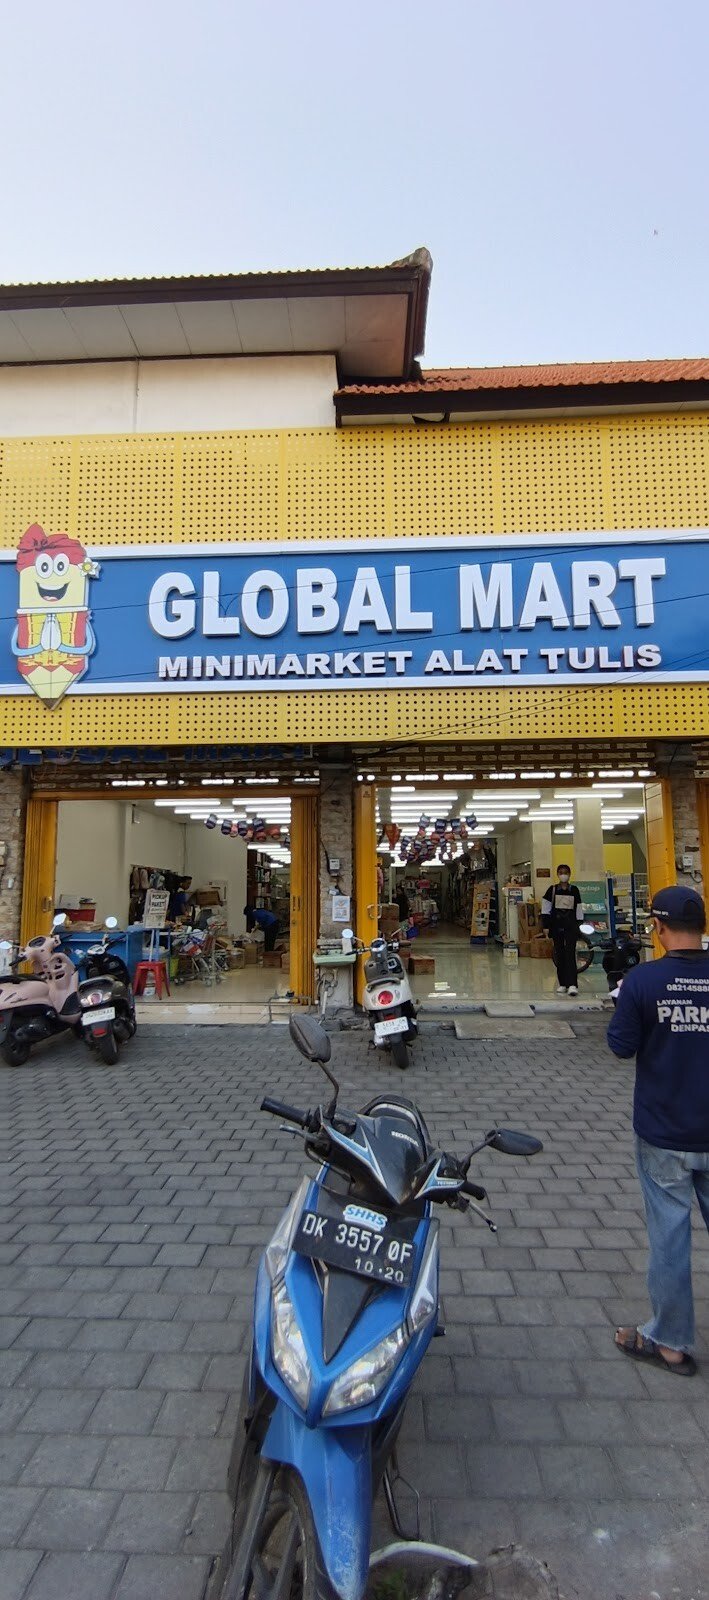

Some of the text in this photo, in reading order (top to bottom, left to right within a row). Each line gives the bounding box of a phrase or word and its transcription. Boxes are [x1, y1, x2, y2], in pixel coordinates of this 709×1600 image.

[148, 557, 667, 640] GLOBAL MART
[158, 644, 663, 679] MINIMARKET ALAT TULIS
[391, 1130, 419, 1147] HONDA
[346, 1206, 386, 1225] SHHS
[302, 1213, 327, 1238] DK
[335, 1223, 384, 1256] 3557
